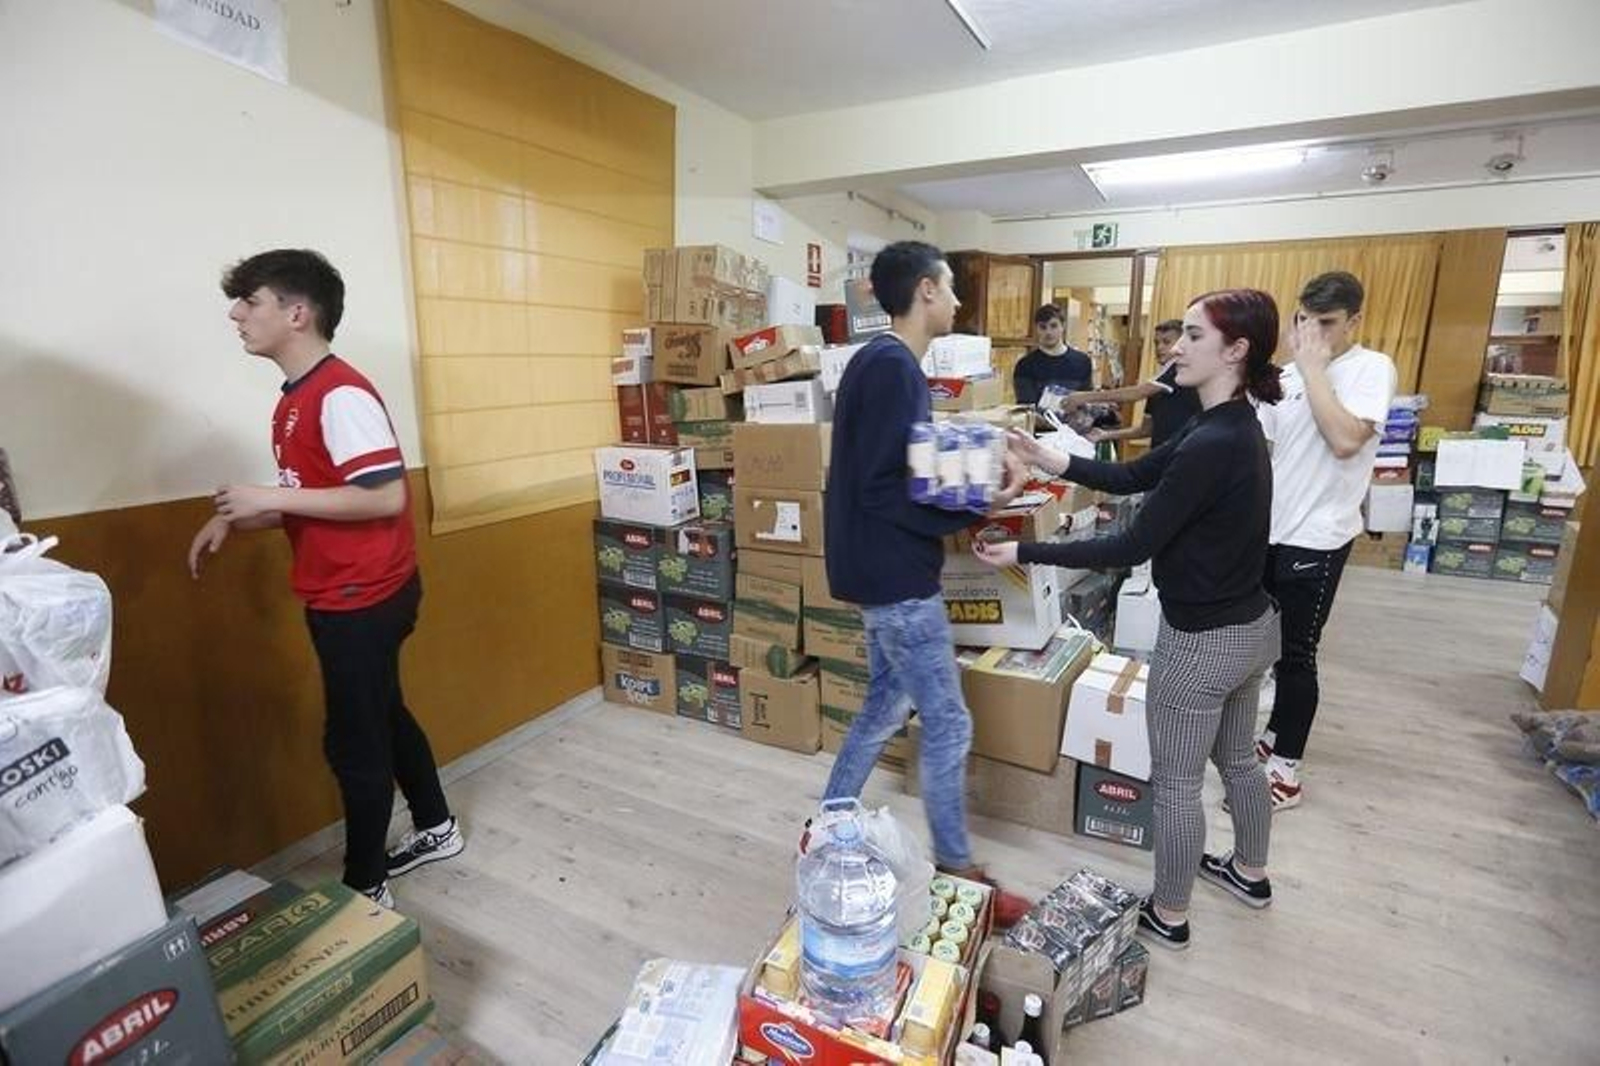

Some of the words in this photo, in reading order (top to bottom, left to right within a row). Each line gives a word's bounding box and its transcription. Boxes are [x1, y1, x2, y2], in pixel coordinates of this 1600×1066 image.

[945, 602, 1000, 621] ADIS
[15, 765, 78, 809] contigo
[1099, 784, 1137, 800] ABRIL
[83, 997, 171, 1064] ABRIL
